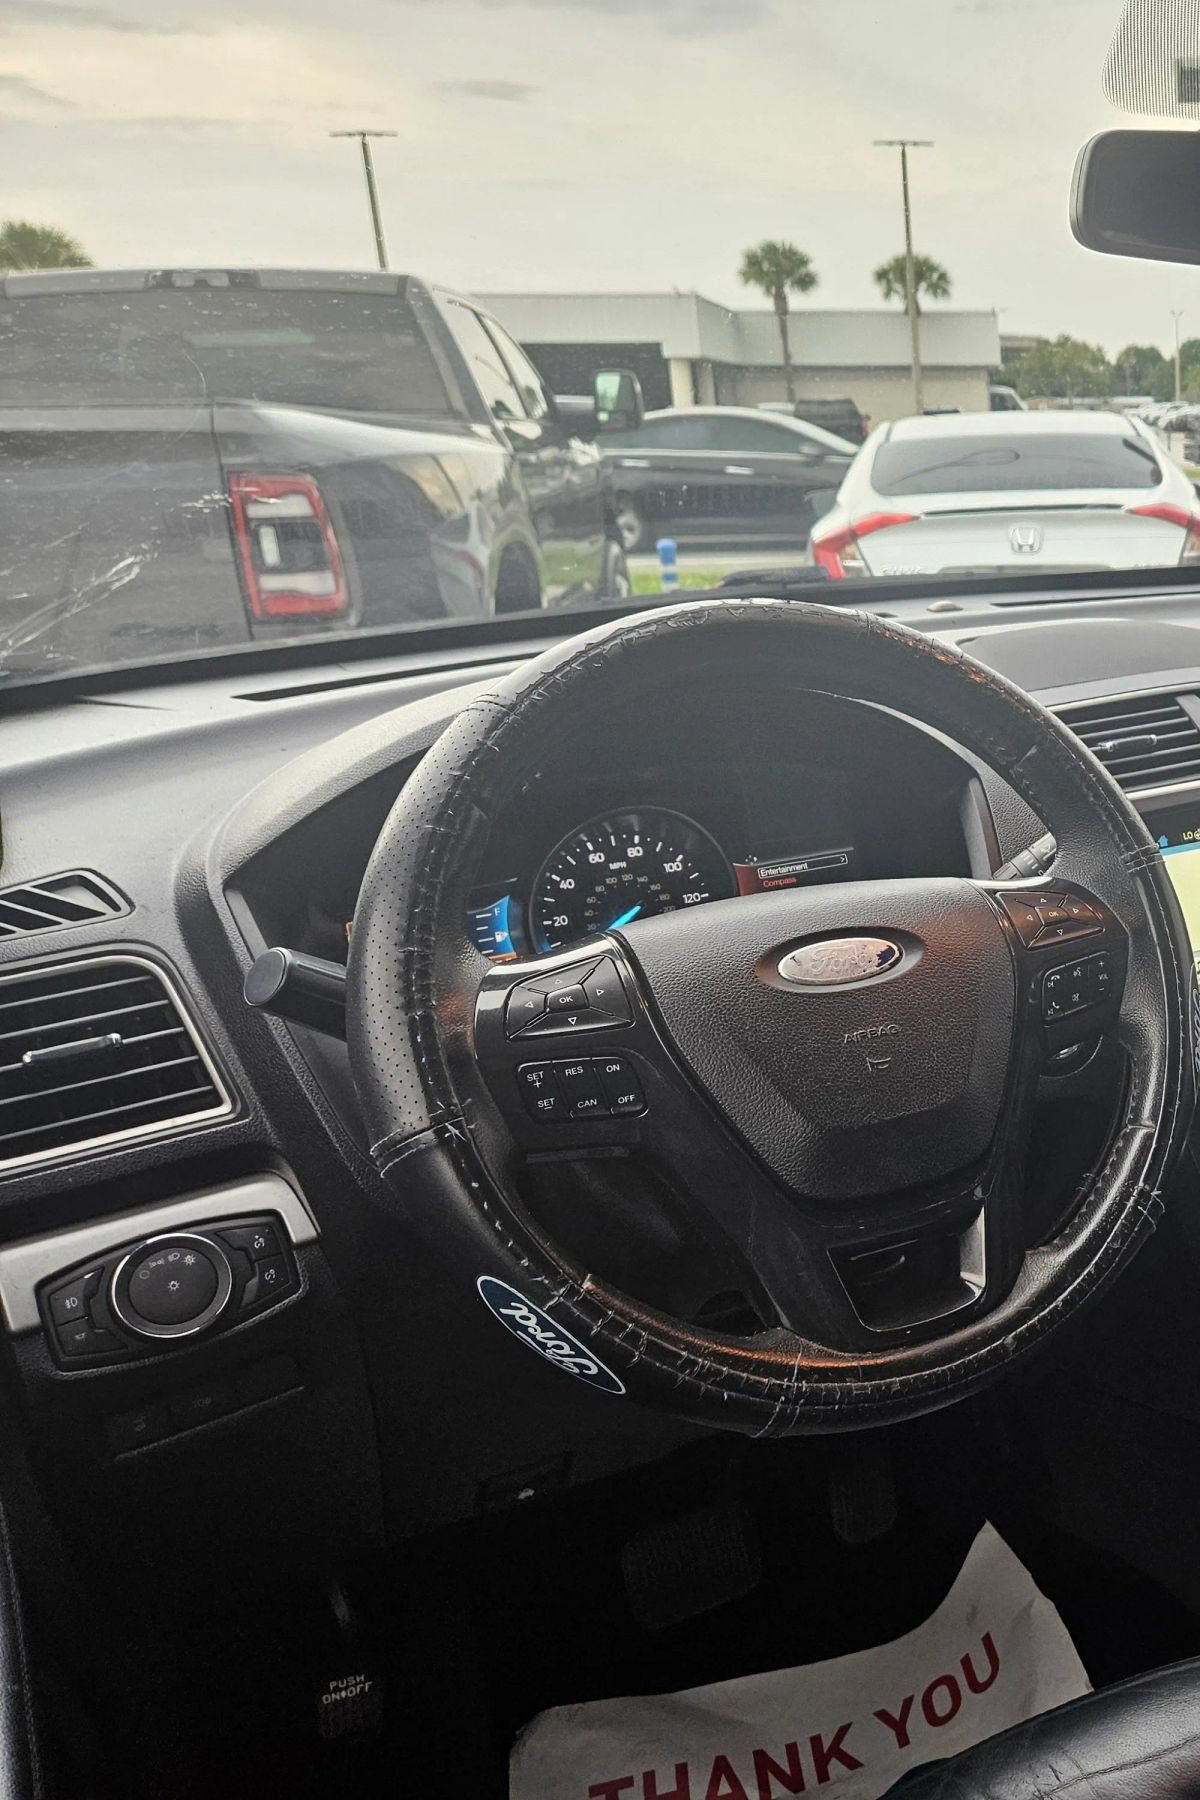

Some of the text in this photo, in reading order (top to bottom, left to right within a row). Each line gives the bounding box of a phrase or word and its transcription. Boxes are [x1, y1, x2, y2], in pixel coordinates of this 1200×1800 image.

[1183, 831, 1194, 841] LO
[588, 852, 605, 863] 60
[627, 846, 643, 858] 80
[609, 861, 627, 870] MPH
[663, 862, 682, 873] 100
[760, 862, 808, 877] Entertainment
[559, 878, 575, 890] 40
[763, 876, 797, 888] Compass
[683, 892, 701, 904] 120
[553, 915, 568, 926] 20
[559, 995, 573, 1004] OK
[565, 1066, 583, 1077] RES
[606, 1064, 620, 1073] ON
[527, 1071, 544, 1082] SET
[537, 1098, 555, 1108] SET
[577, 1099, 597, 1109] CAN
[617, 1094, 636, 1104] OFF
[499, 1302, 598, 1374] Ford
[329, 1674, 365, 1691] PUSH
[873, 1632, 1000, 1750] YOU
